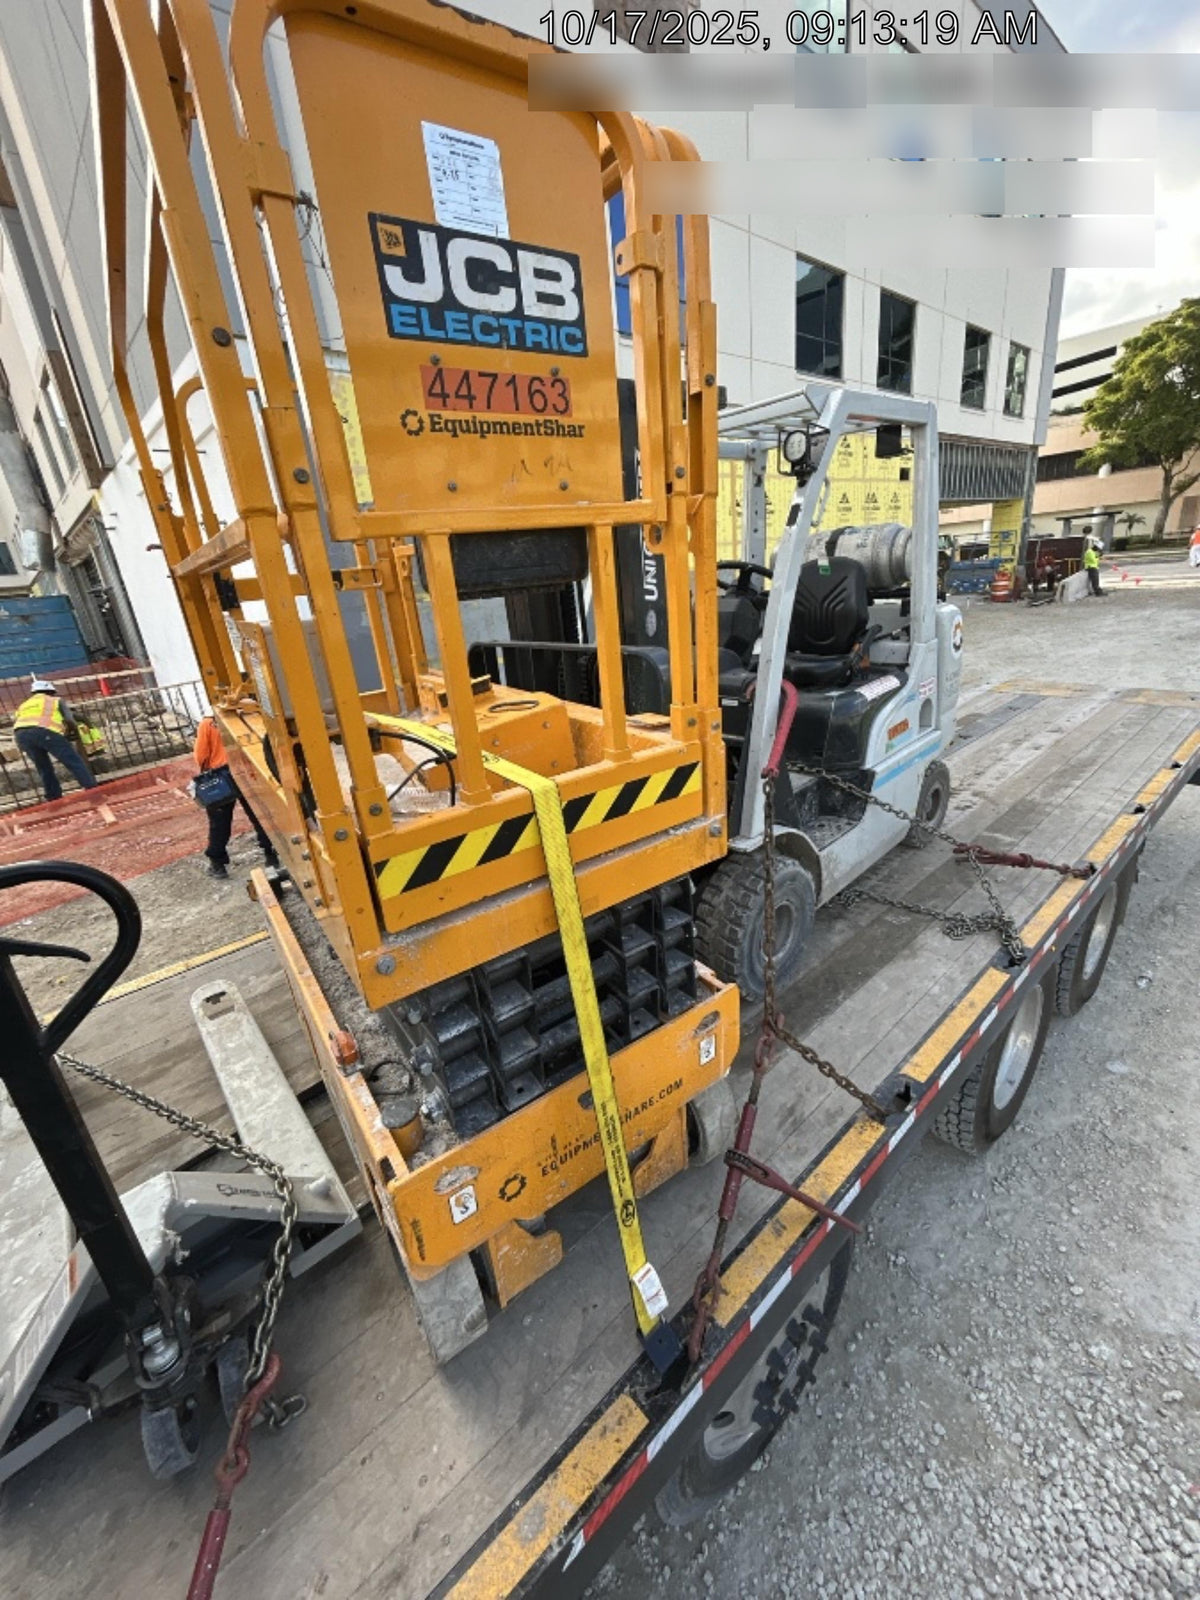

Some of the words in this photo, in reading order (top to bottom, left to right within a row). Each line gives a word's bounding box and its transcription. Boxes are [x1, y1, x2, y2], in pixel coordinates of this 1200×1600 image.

[383, 229, 580, 322] JCB
[389, 303, 584, 353] ELECTRIC
[427, 367, 570, 415] 447163
[540, 1077, 684, 1178] EQUIPMEHARE.COM
